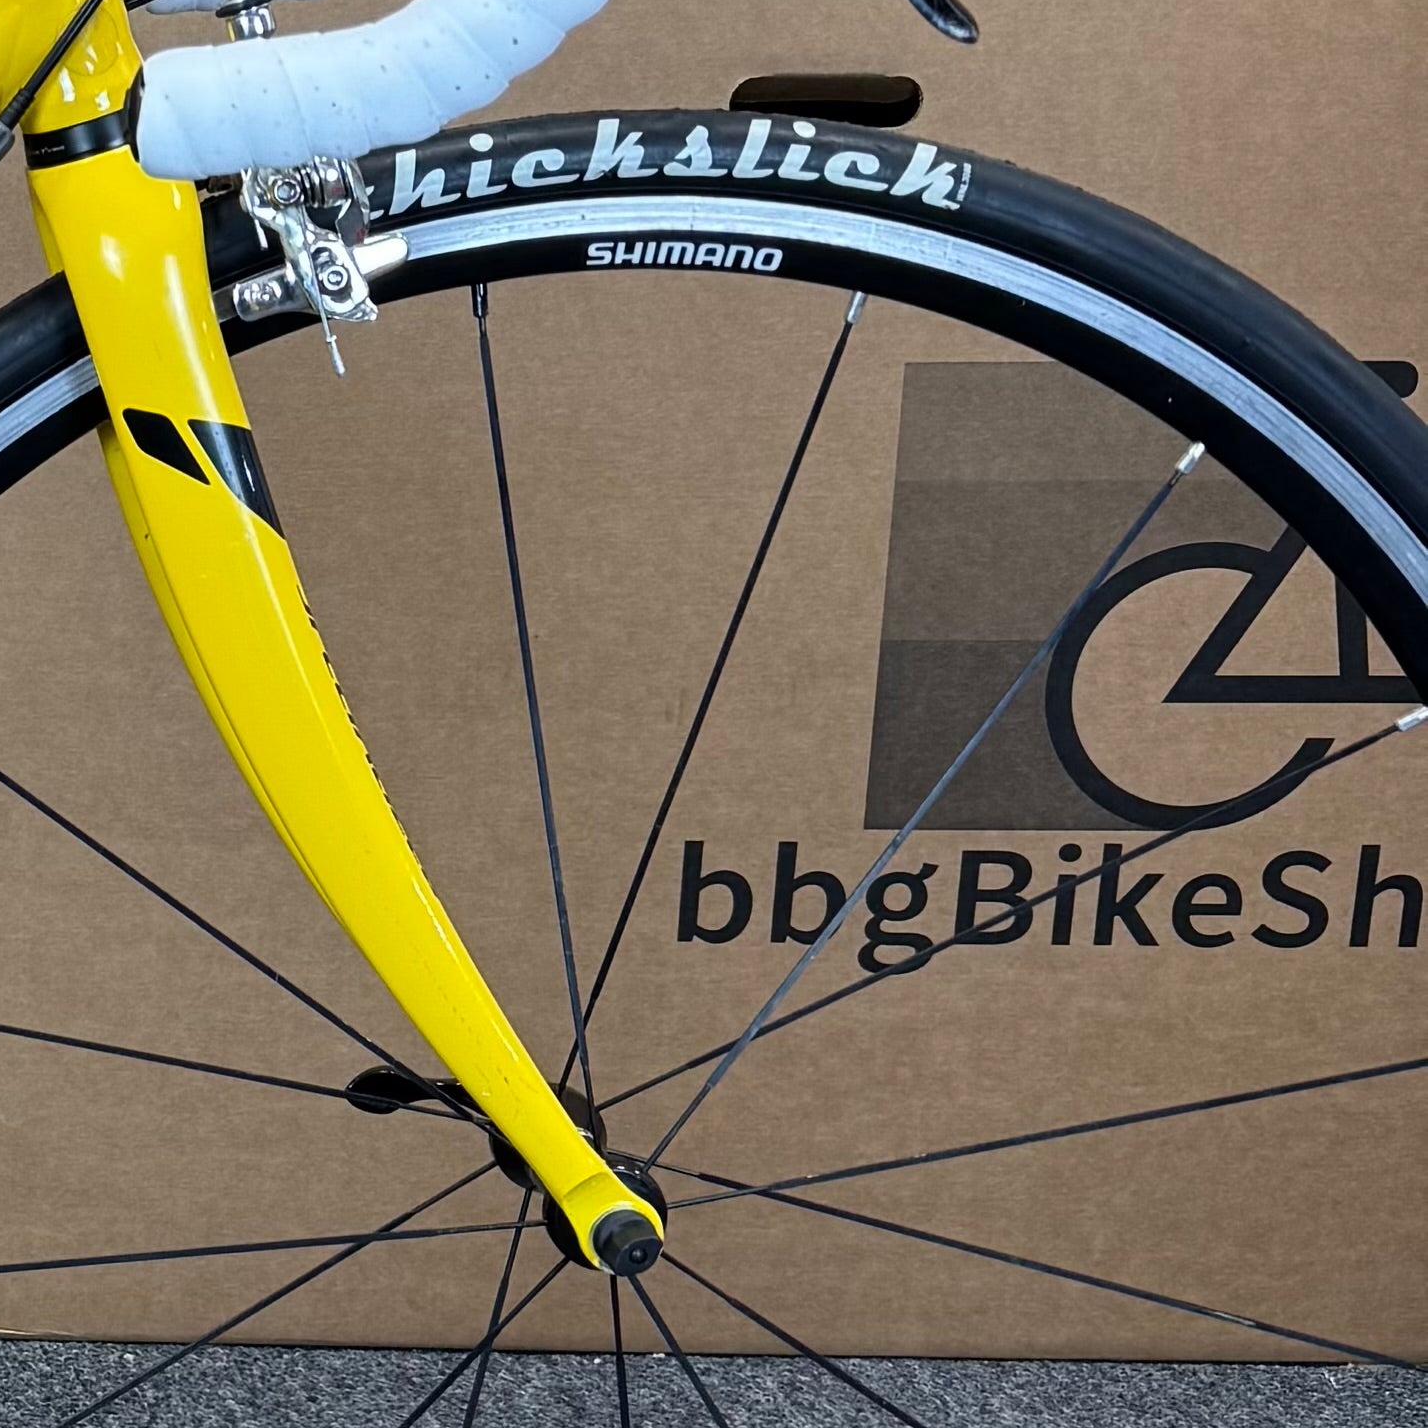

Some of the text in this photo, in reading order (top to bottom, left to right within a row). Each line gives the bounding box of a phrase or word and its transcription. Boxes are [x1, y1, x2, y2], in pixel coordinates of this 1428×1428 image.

[370, 118, 961, 220] hickslick
[585, 241, 784, 273] SHIMANO
[676, 839, 1423, 975] bbgBikeSh
